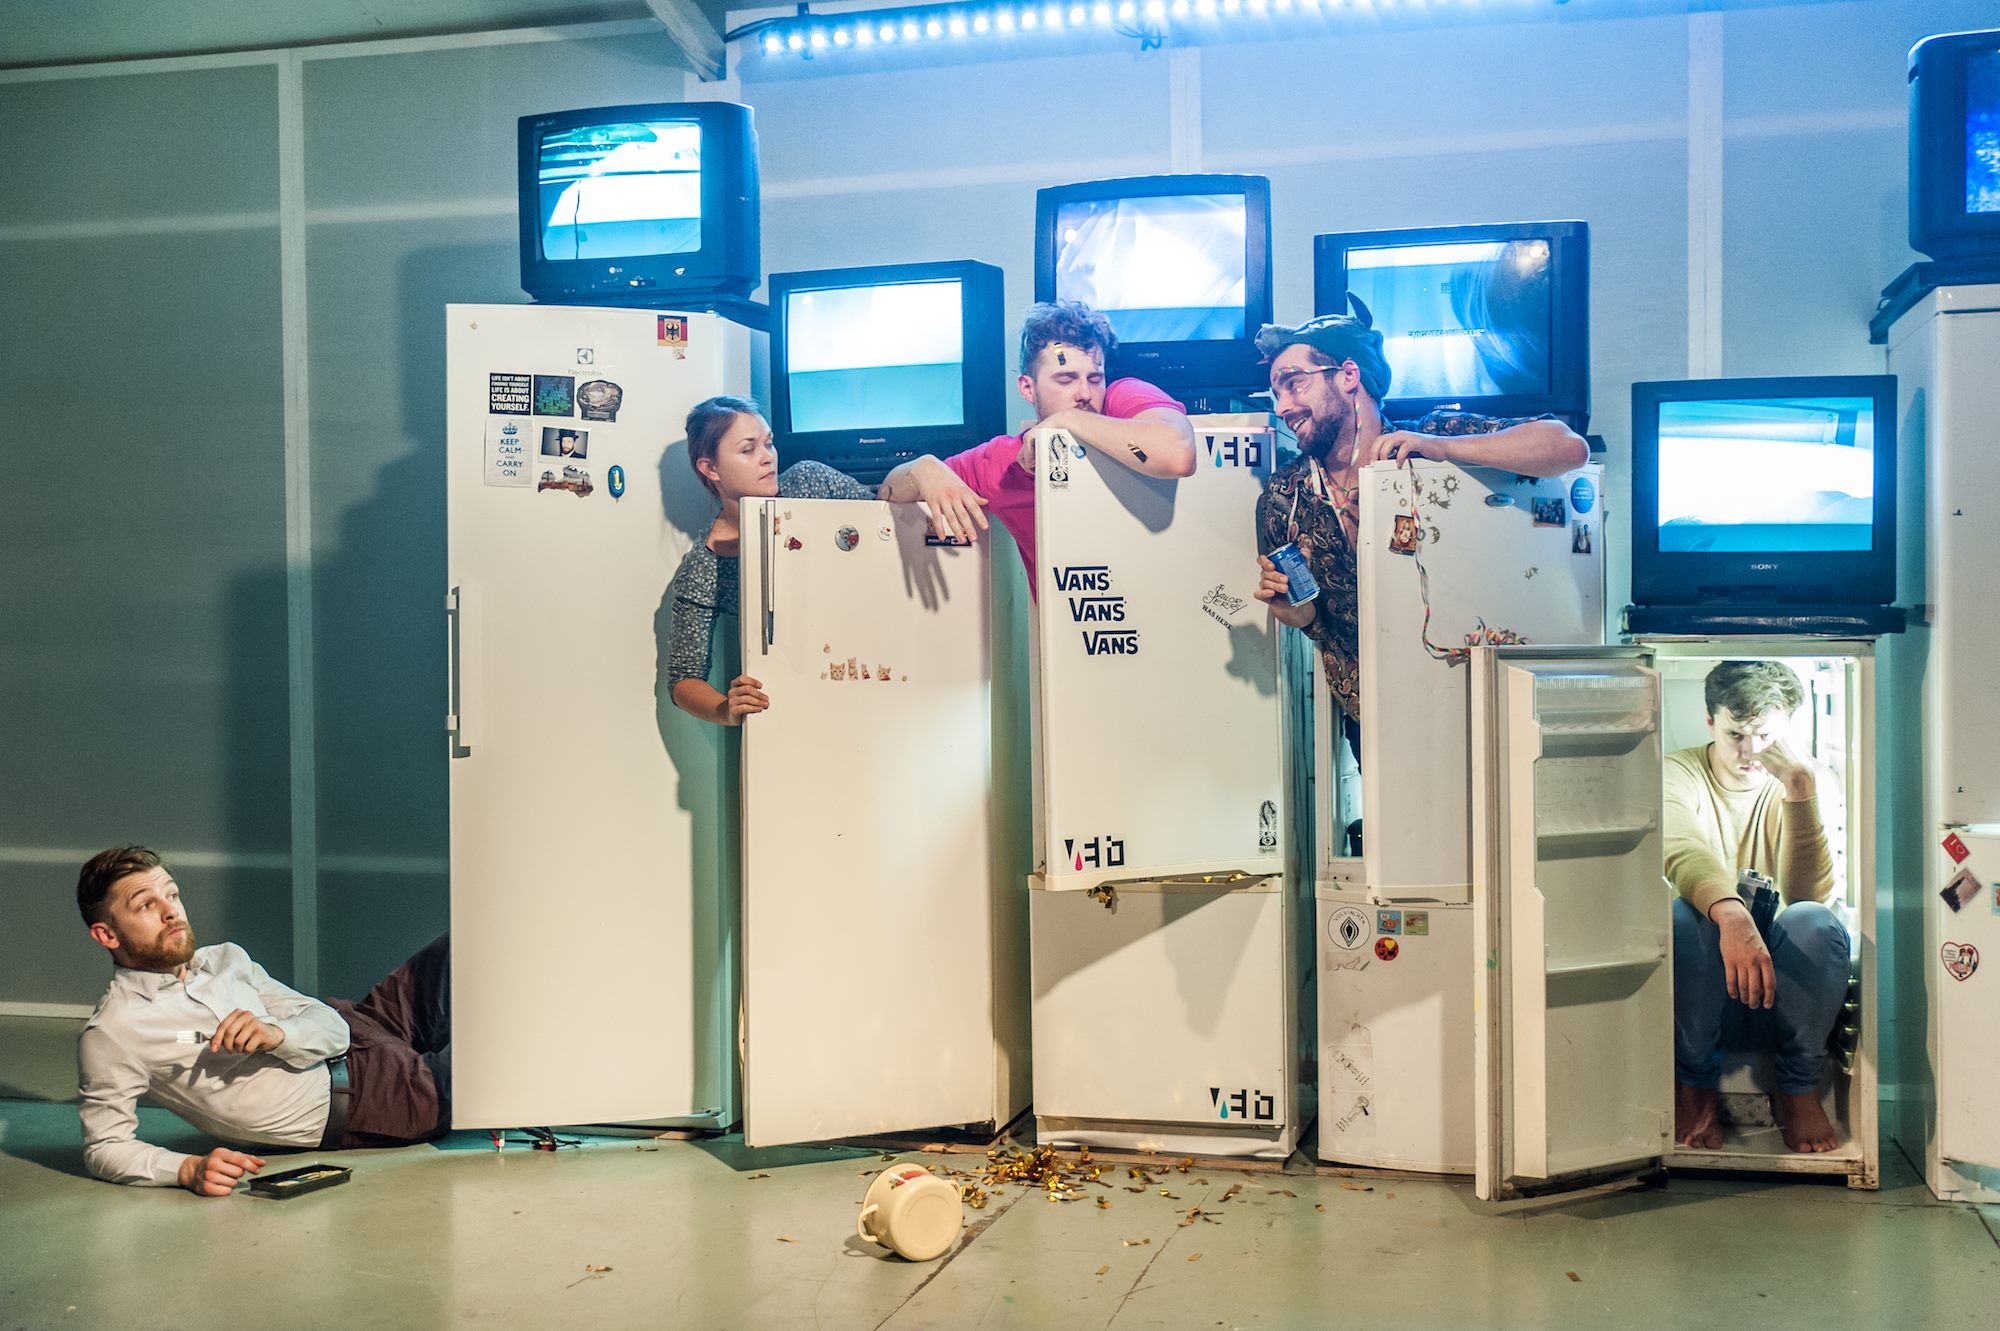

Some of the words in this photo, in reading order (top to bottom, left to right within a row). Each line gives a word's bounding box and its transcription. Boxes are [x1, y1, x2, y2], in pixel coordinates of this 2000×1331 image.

[491, 393, 530, 403] CREATING
[491, 402, 530, 412] YOURSELF.
[498, 446, 522, 454] CALM
[496, 460, 524, 468] CARRY
[502, 469, 517, 477] ON
[1053, 566, 1110, 591] VANS
[1068, 597, 1125, 622] VANS
[1202, 604, 1216, 618] WAS
[1082, 630, 1139, 655] VANS
